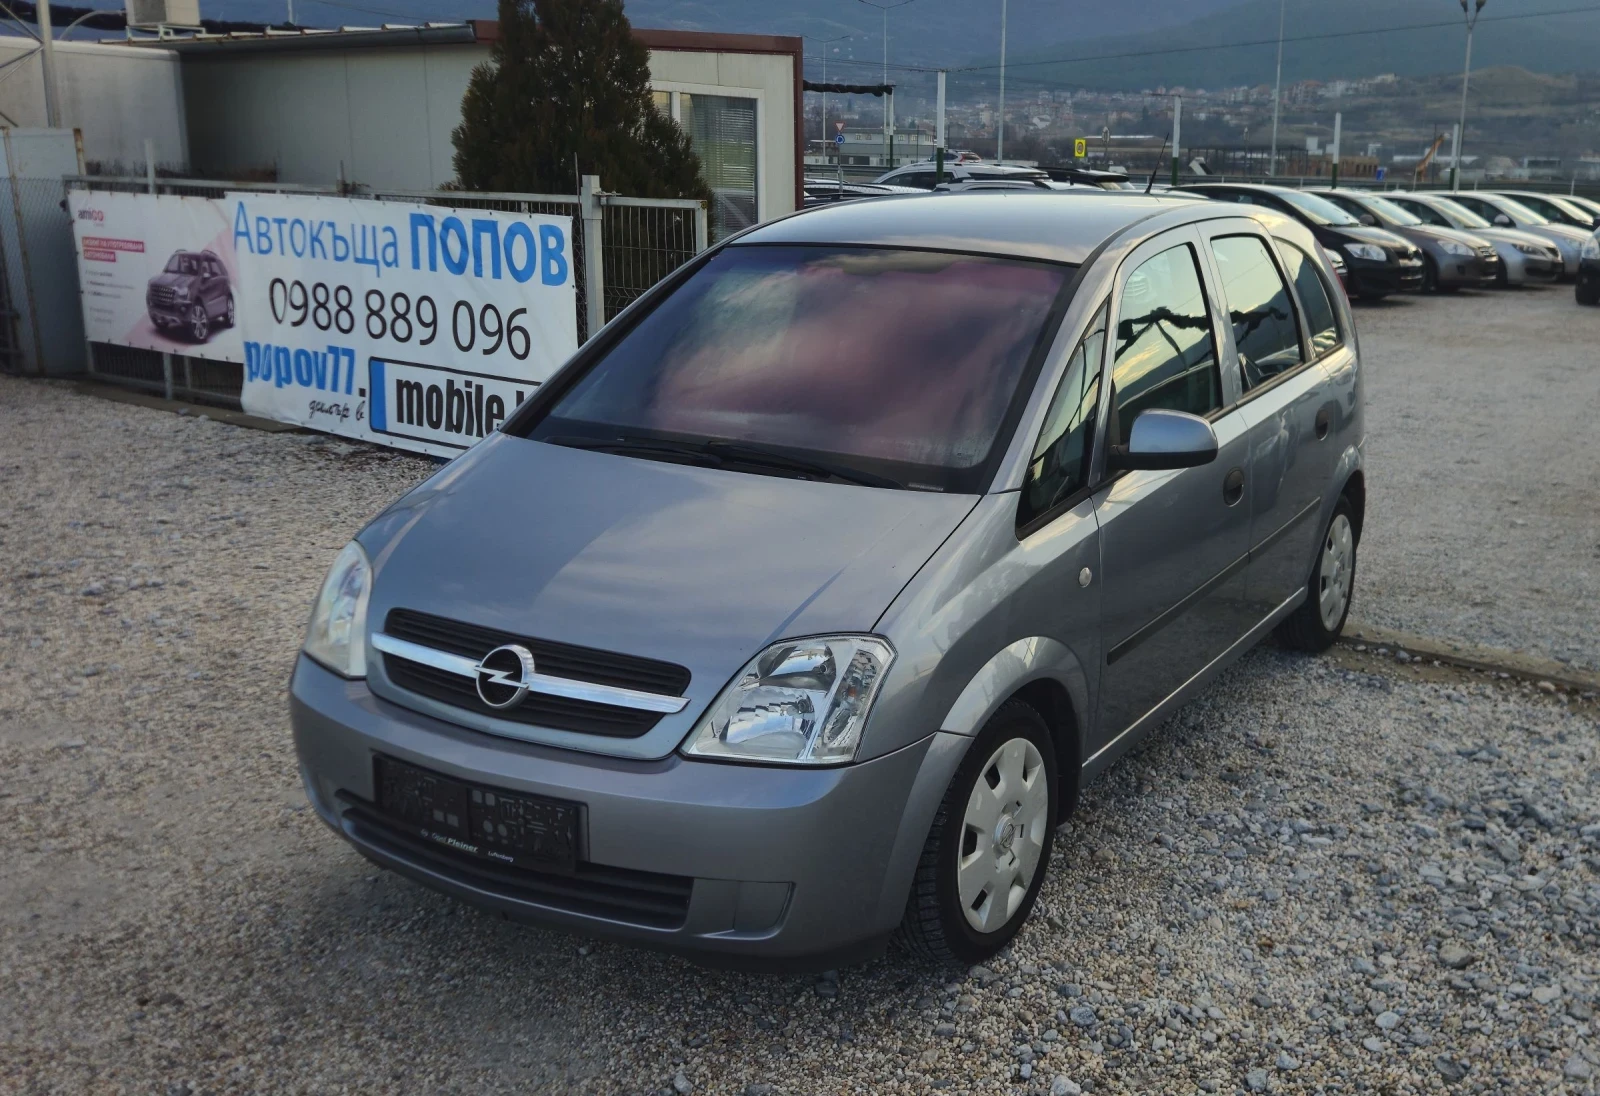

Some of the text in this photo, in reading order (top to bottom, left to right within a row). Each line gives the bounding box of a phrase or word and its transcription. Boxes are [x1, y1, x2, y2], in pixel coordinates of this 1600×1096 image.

[233, 201, 567, 287] Автокъща ПОПОВ
[269, 277, 531, 361] 0988 889 096
[396, 378, 525, 437] mobile
[447, 837, 479, 853] Pleiner
